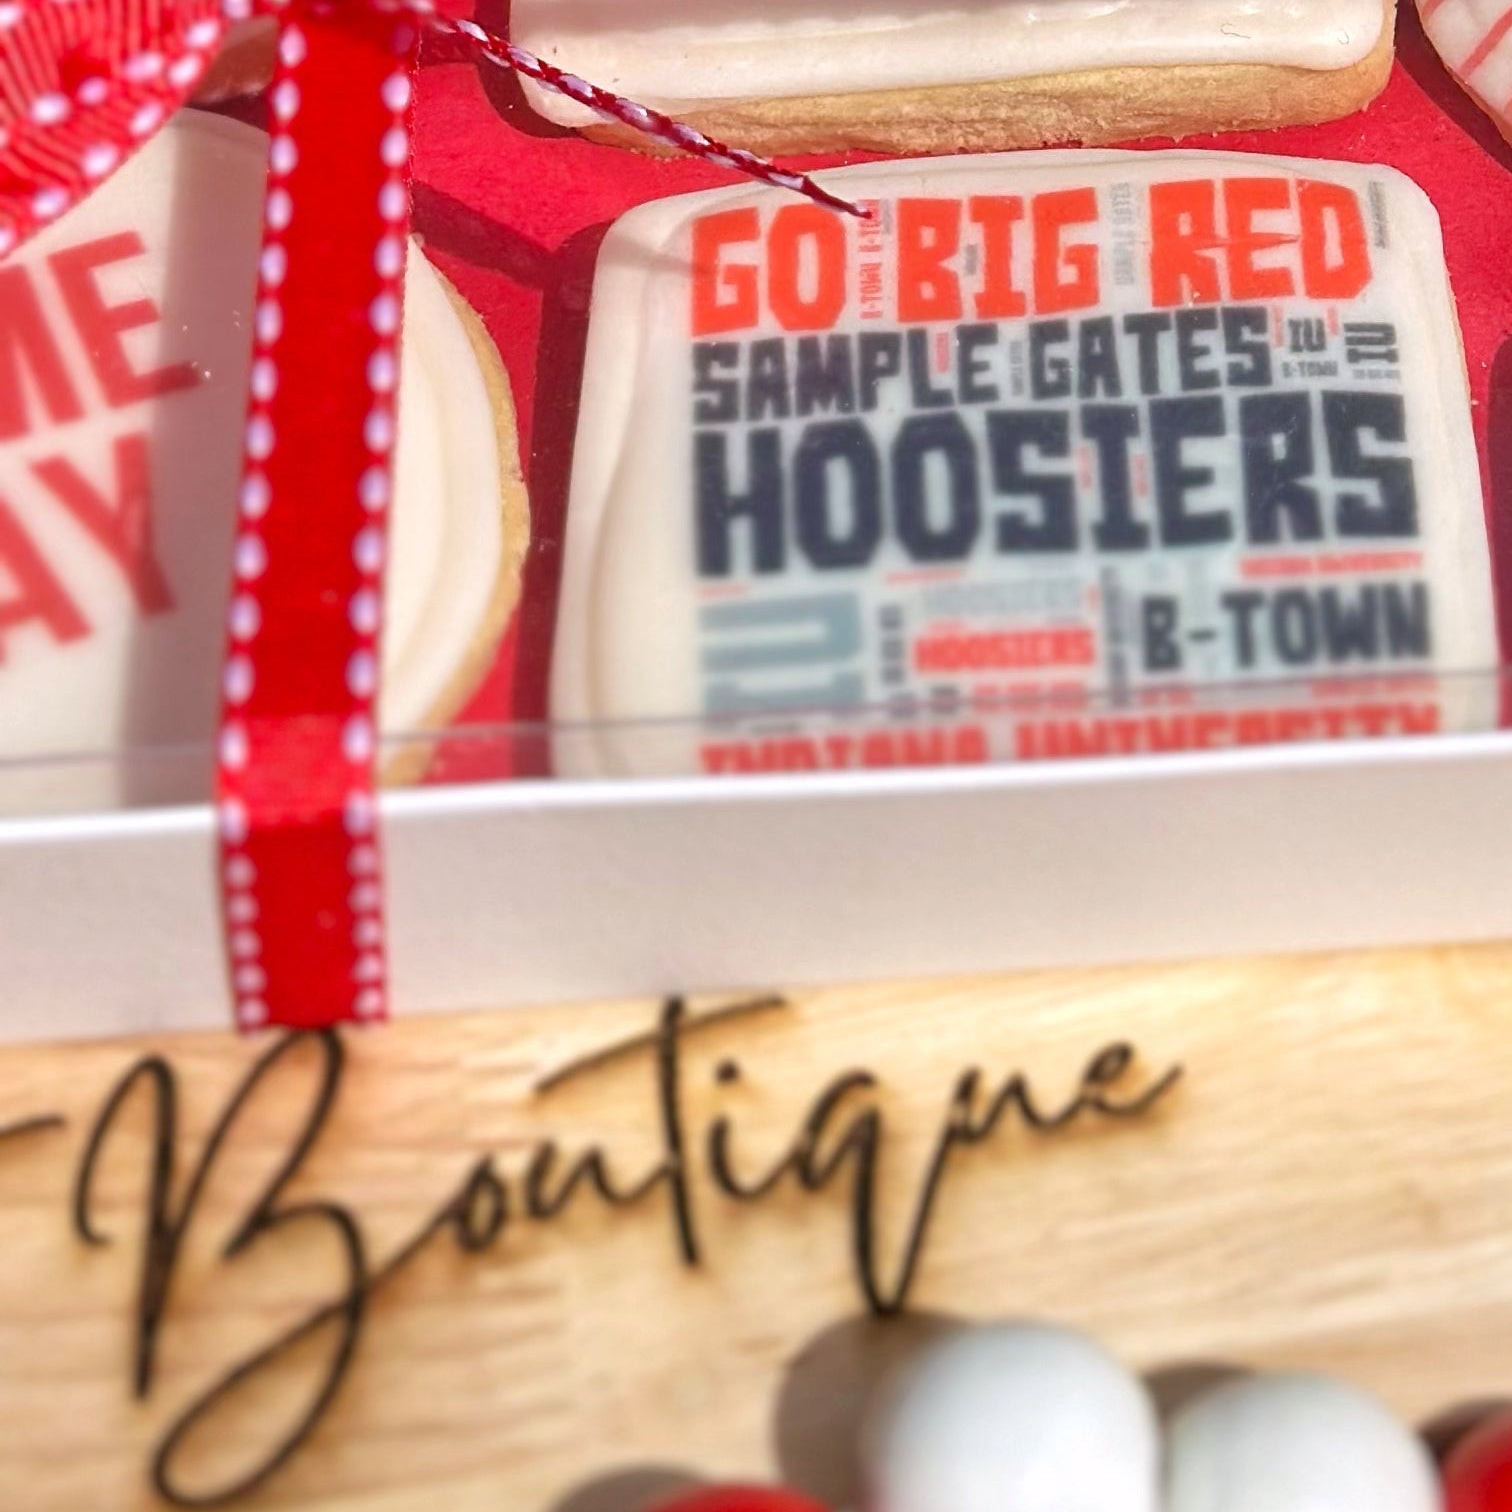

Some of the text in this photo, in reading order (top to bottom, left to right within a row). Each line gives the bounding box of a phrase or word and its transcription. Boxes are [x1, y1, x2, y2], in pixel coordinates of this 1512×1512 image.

[692, 203, 848, 337] GO
[896, 186, 1100, 323] BIG
[1149, 176, 1373, 308] RED
[693, 323, 1000, 424] SAMPLE
[1029, 305, 1273, 401] GATES
[1288, 317, 1327, 354] IU
[694, 386, 1419, 579] HOOSIERS
[1142, 580, 1433, 674] B-TOWN
[74, 992, 1184, 1508] Boutique
